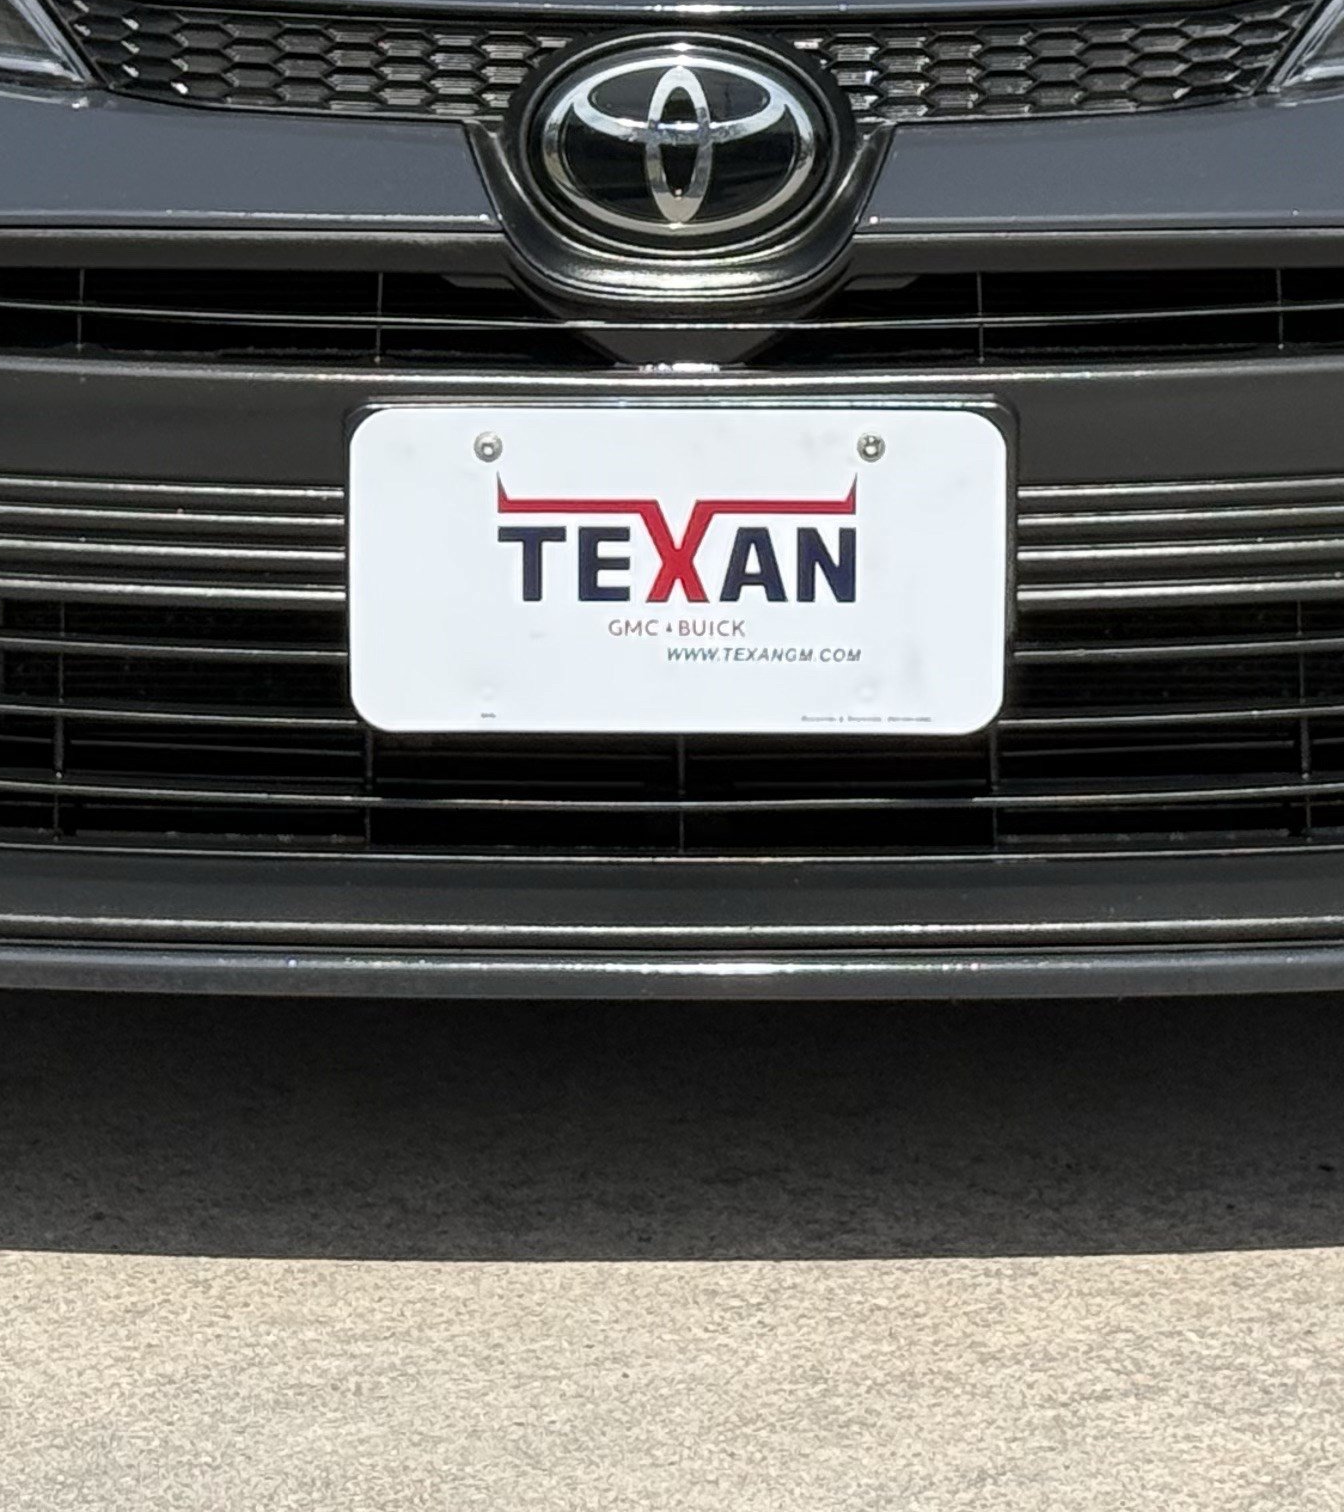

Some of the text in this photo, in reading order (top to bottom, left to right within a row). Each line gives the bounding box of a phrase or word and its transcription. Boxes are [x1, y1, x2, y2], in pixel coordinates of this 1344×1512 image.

[497, 500, 857, 603] TEXAN
[607, 619, 747, 638] GMC BUICK
[666, 647, 862, 663] WWW.TEXANGM.COM
